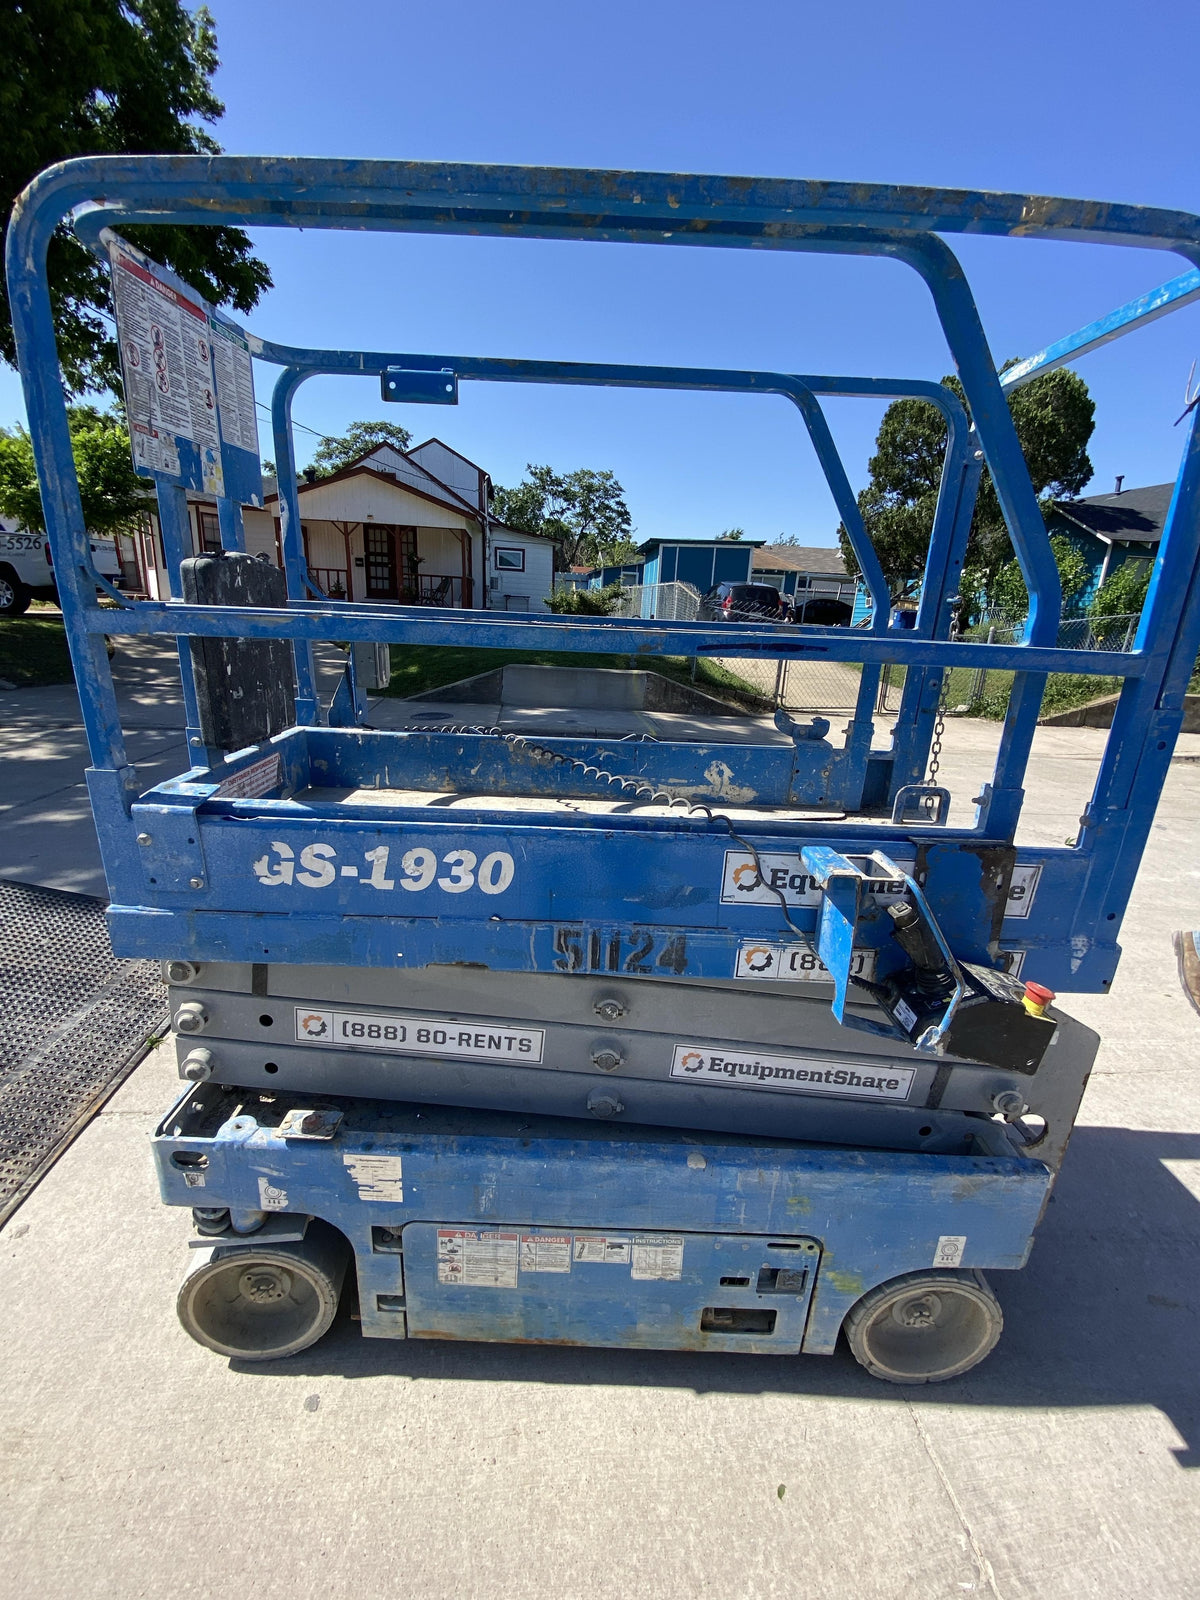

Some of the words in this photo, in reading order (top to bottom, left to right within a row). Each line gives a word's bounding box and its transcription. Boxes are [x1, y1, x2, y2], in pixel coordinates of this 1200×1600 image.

[155, 279, 177, 302] DANGER
[0, 537, 42, 550] -5526
[253, 841, 515, 894] GS-1930
[790, 951, 865, 974] (8)
[342, 1020, 407, 1042] (888)
[417, 1028, 532, 1053] 80-RENTS
[708, 1057, 899, 1090] EquipmentShare
[534, 1236, 566, 1244] DANGER
